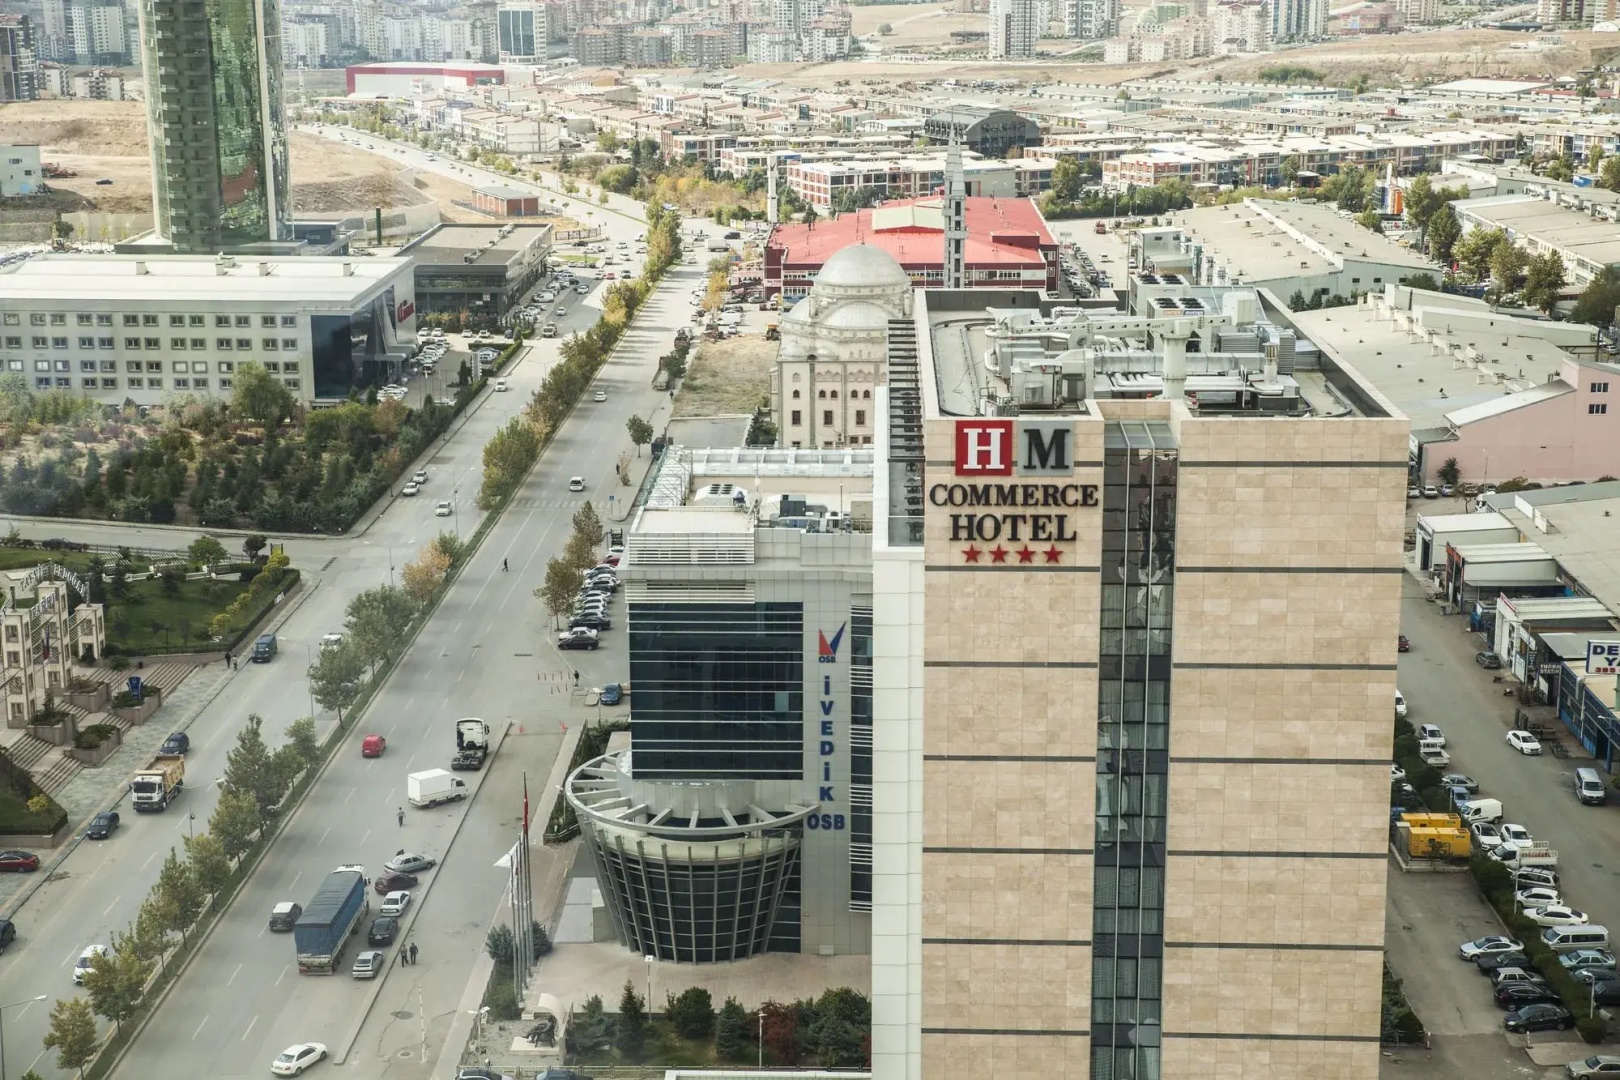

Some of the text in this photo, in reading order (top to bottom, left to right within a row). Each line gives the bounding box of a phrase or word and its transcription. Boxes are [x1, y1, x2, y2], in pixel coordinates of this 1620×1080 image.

[929, 483, 1099, 507] COMMERCE
[949, 513, 1077, 542] HOTEL
[818, 656, 836, 664] OSB
[806, 813, 846, 831] OSB
